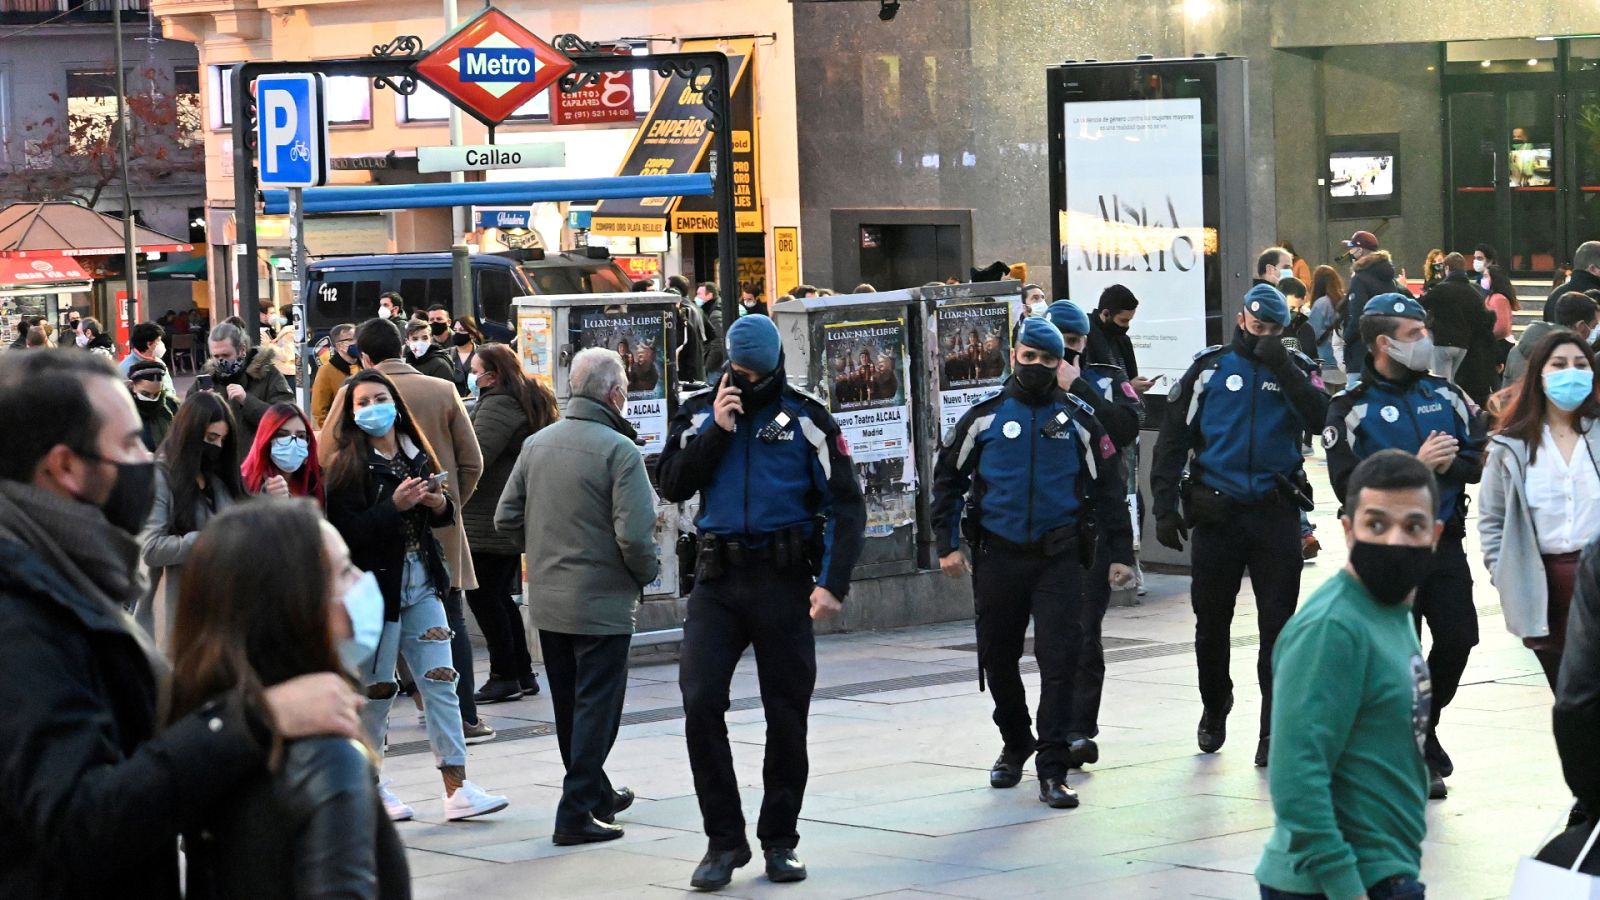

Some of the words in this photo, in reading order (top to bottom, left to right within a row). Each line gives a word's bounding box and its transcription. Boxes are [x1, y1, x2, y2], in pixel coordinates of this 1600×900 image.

[466, 52, 531, 75] Metro
[574, 111, 590, 119] (91)
[264, 90, 298, 173] P
[648, 116, 706, 137] EMPEÑOS
[466, 149, 521, 165] Callao
[677, 214, 719, 230] EMPEÑOS
[779, 240, 793, 252] ORO
[322, 288, 337, 301] 112
[854, 414, 875, 425] Teatro
[862, 427, 884, 437] Madrid
